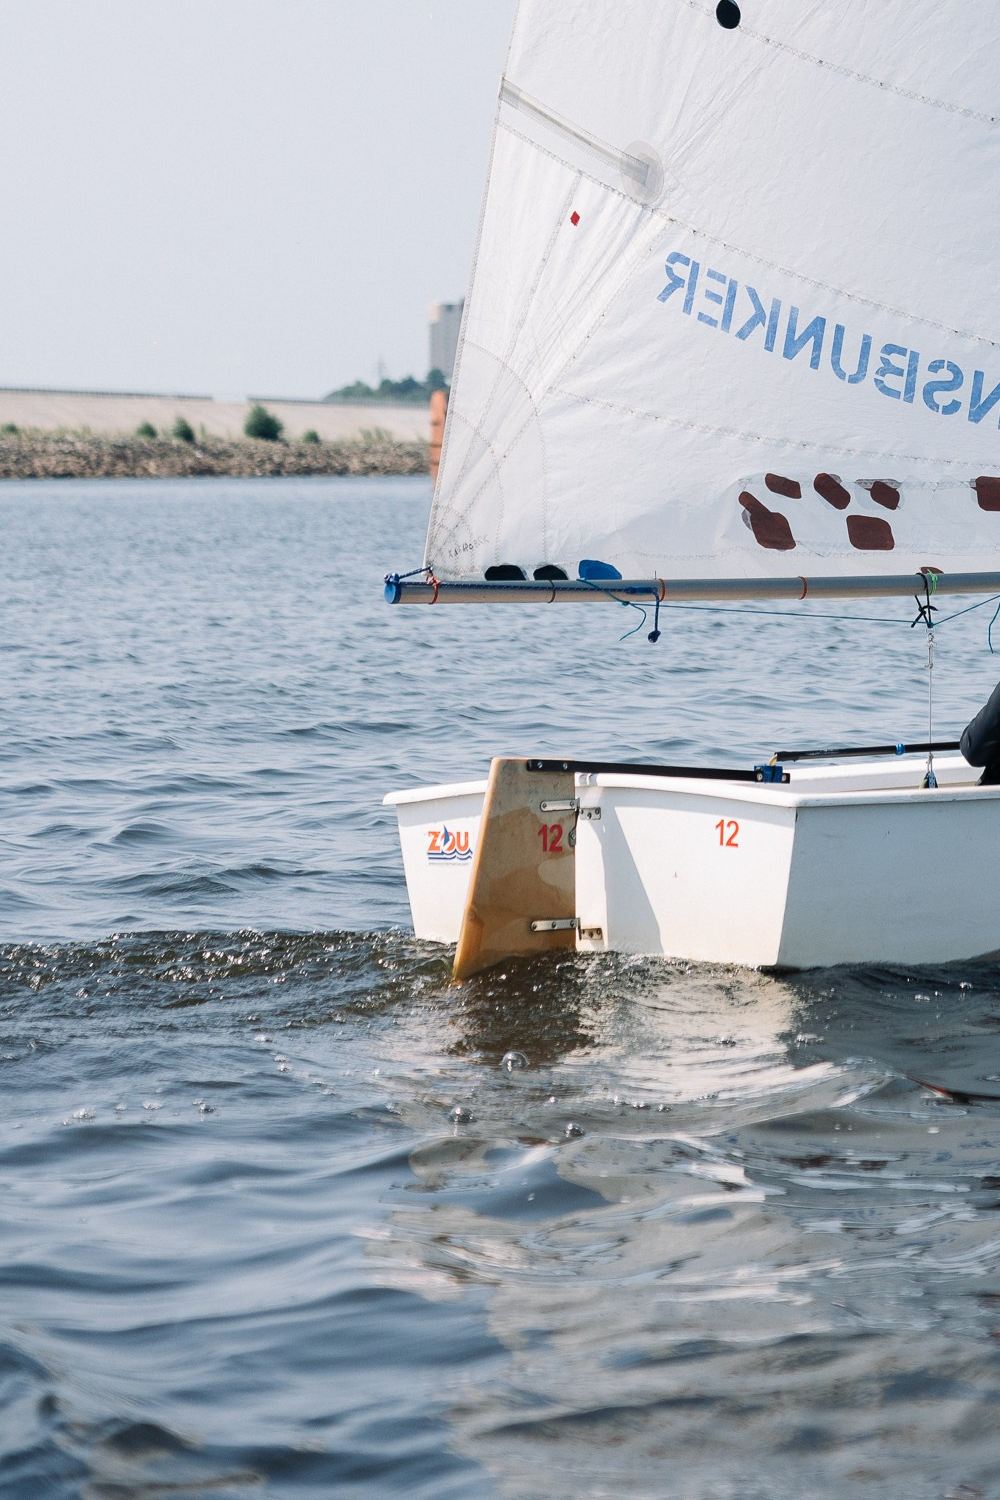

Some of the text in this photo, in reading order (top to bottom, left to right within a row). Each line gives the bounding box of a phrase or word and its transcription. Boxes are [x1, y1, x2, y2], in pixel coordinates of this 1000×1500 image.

[428, 831, 469, 852] ZOU
[537, 824, 564, 852] 12
[715, 819, 740, 848] 12
